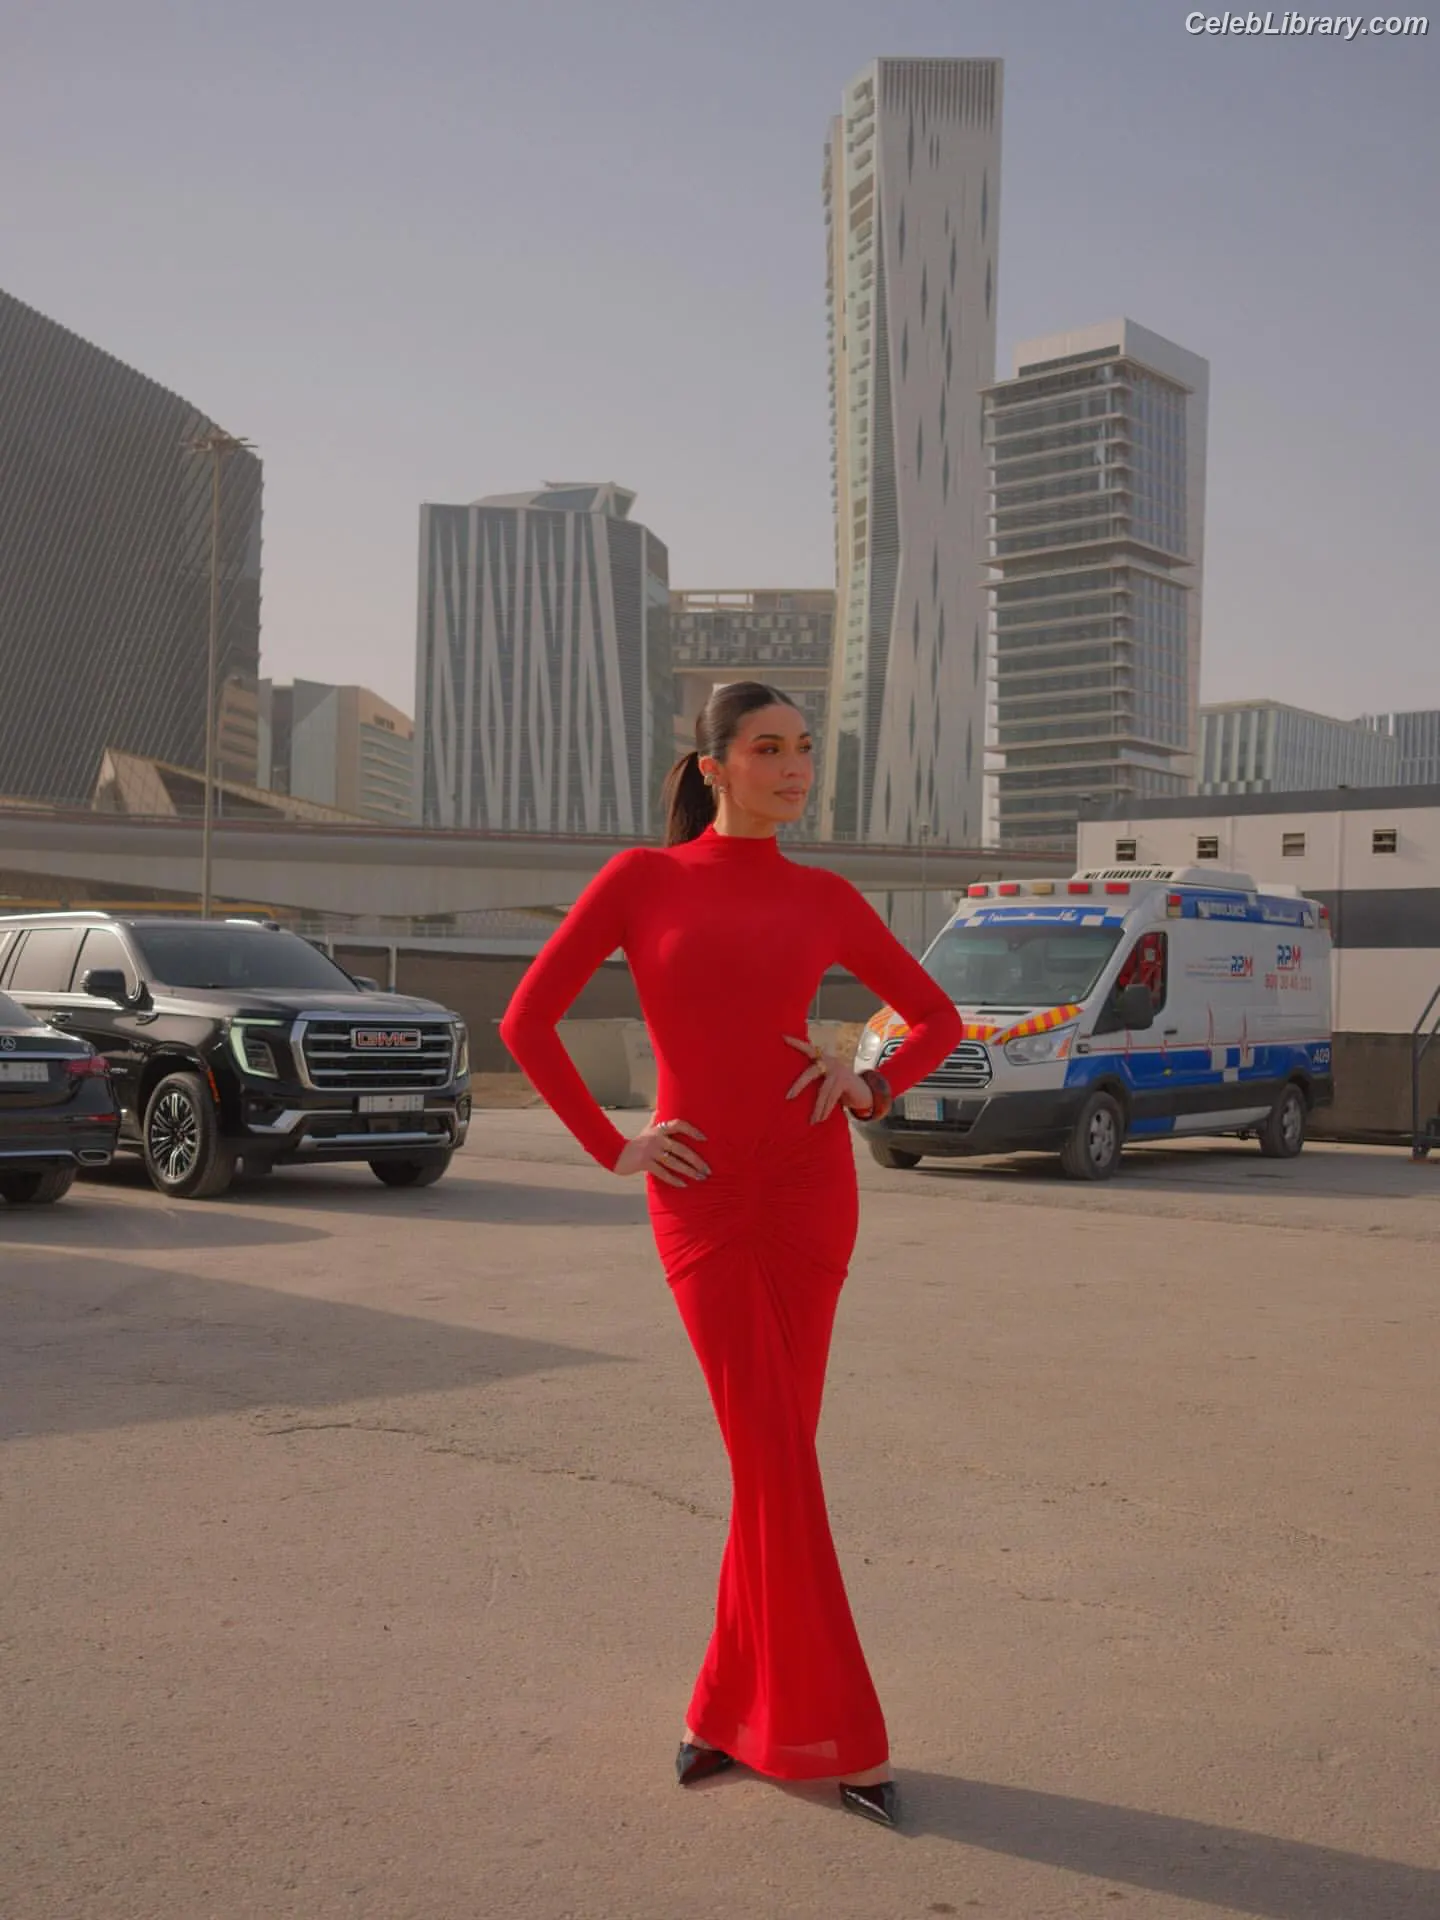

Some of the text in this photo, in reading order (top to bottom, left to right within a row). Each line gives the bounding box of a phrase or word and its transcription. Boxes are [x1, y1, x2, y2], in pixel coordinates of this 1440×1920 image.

[1231, 955, 1253, 977] RPM
[1277, 944, 1302, 970] RPM
[357, 1031, 417, 1047] GMC
